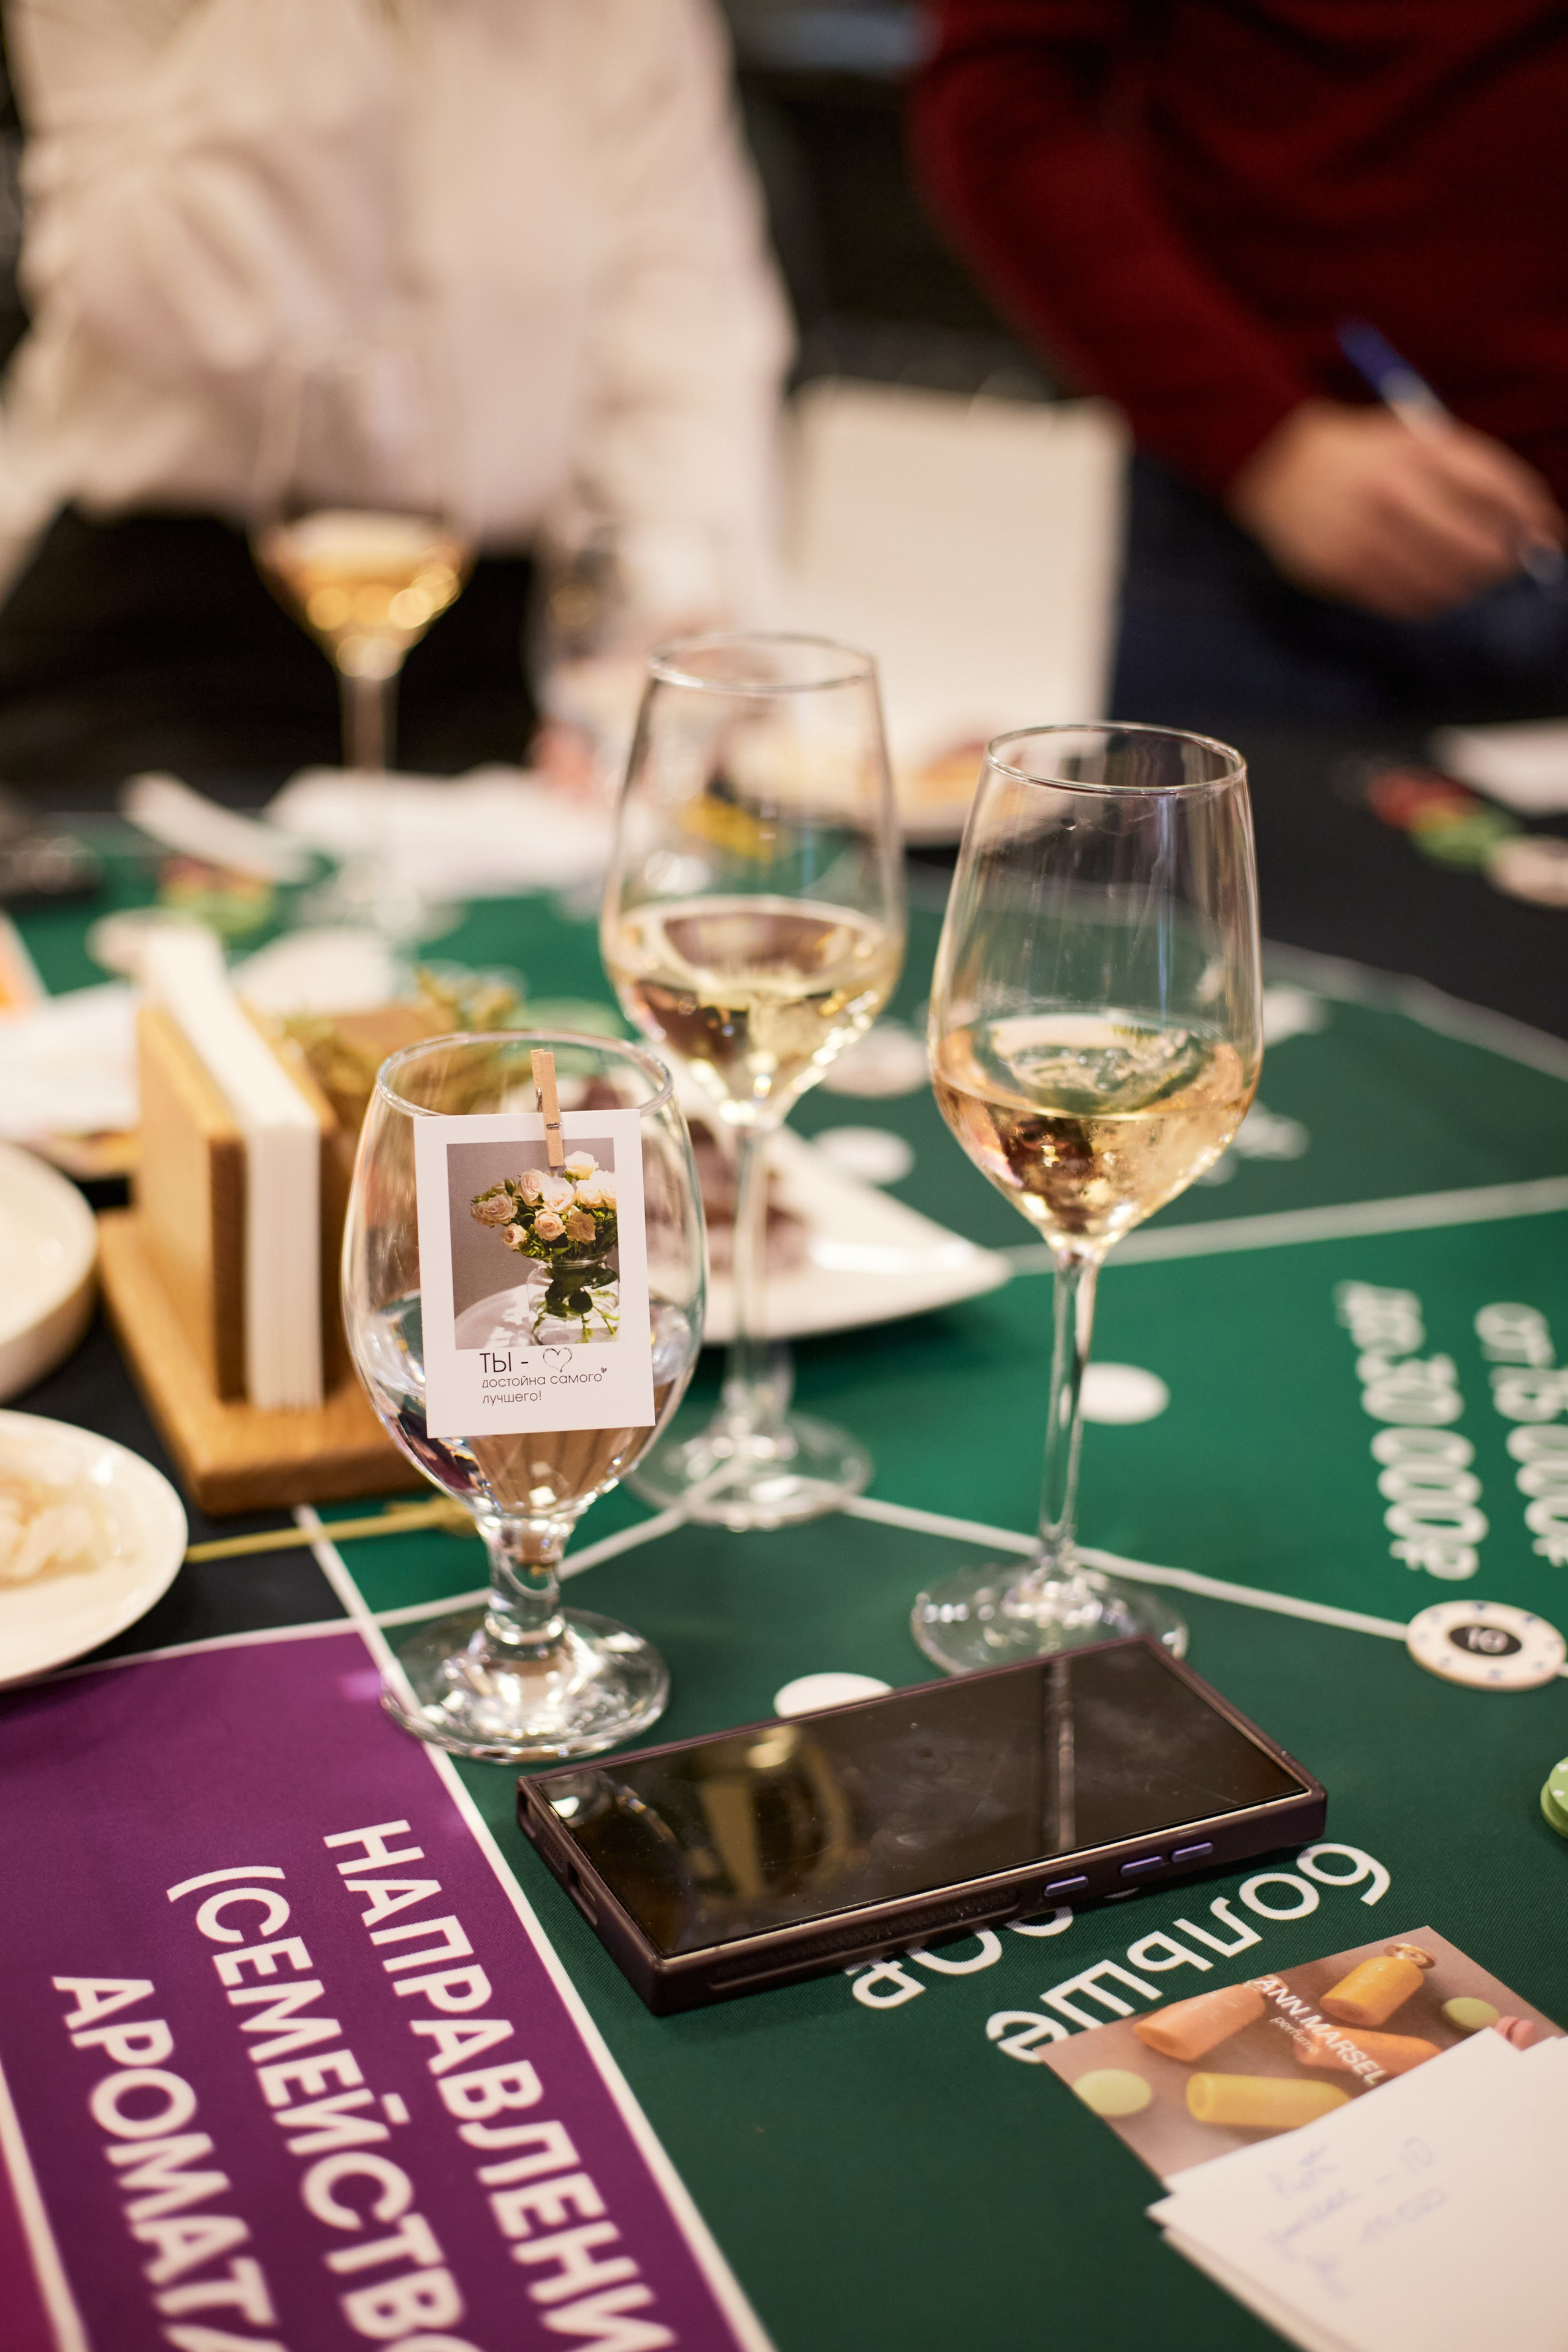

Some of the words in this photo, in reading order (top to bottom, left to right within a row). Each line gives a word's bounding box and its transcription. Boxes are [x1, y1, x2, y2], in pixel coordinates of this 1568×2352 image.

[480, 1351, 512, 1373] ТЫ
[481, 1375, 546, 1389] достойна
[550, 1373, 603, 1385] самого
[482, 1389, 542, 1406] лучшего!
[986, 1842, 1391, 2064] больше
[1254, 1978, 1386, 2086] ANN.MARSEL
[1268, 2016, 1320, 2054] perfume
[166, 1864, 493, 2352] (СЕМЕЙСТВ
